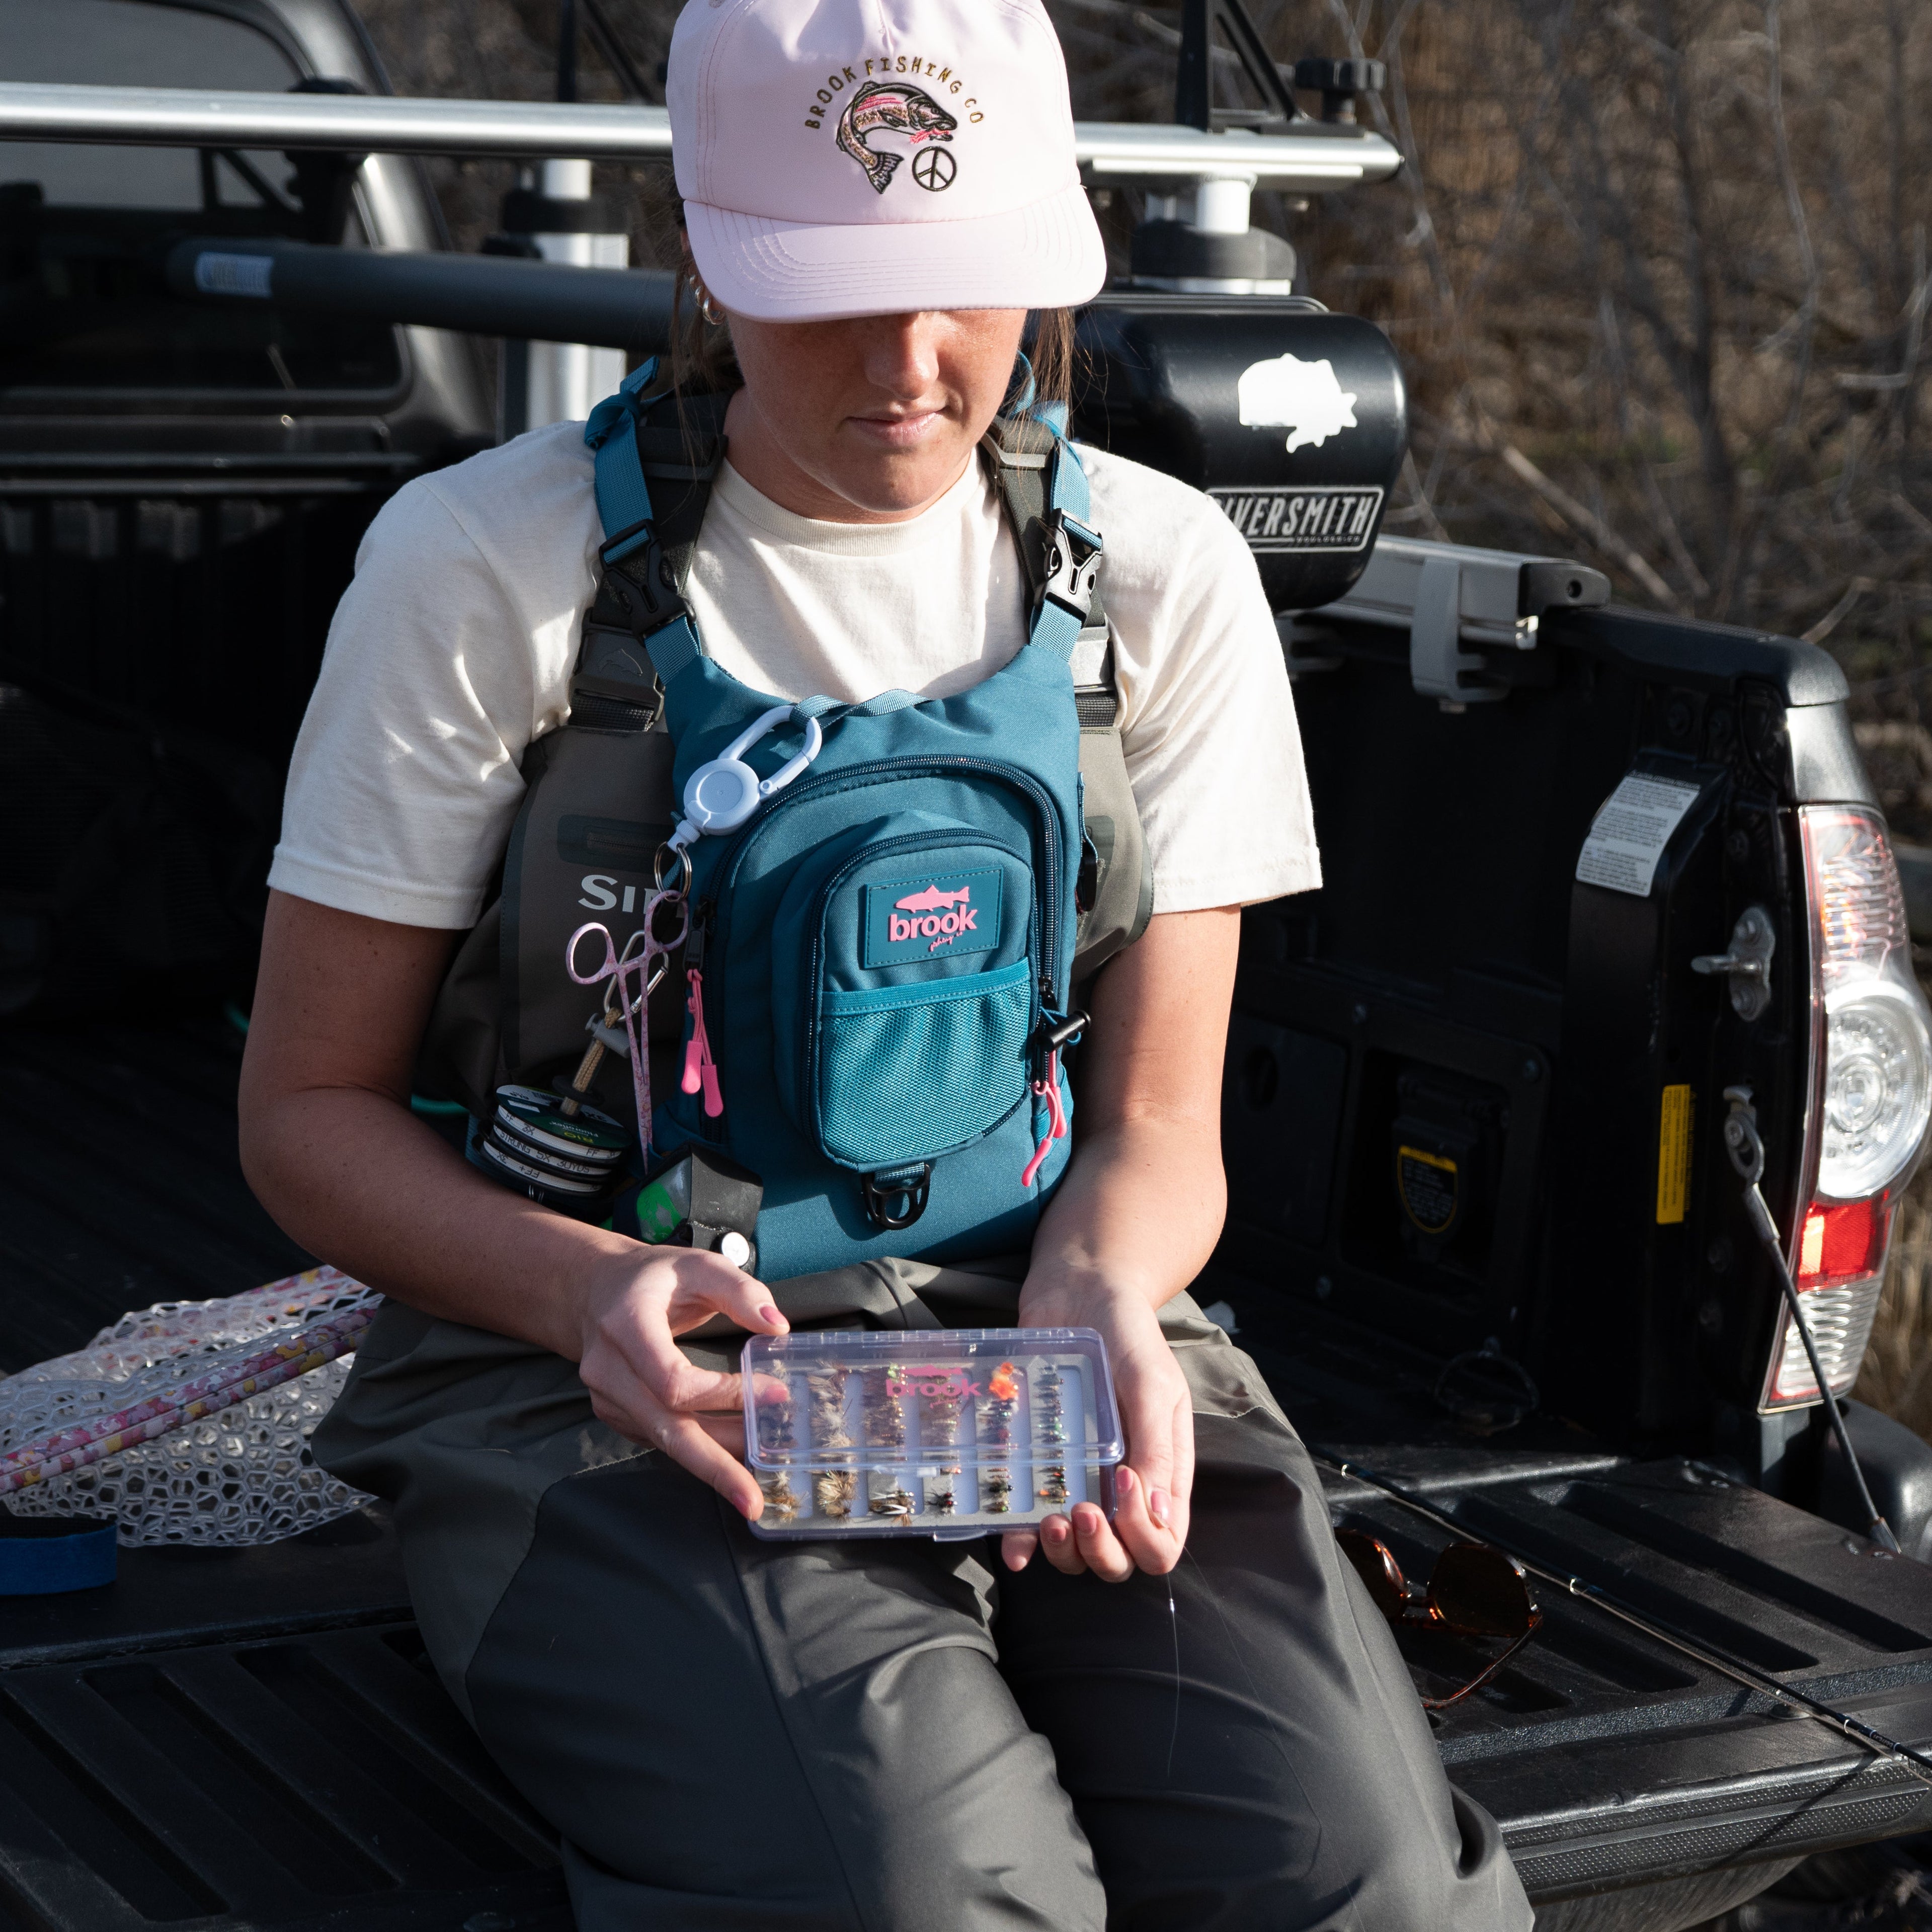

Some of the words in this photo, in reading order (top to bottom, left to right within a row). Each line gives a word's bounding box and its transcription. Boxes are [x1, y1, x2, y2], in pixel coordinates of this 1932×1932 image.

[805, 66, 857, 129] BROOK
[865, 56, 962, 94] FISHING
[964, 98, 984, 123] CO
[1214, 496, 1375, 536] VERSMITH
[890, 904, 978, 941] brook
[564, 1132, 594, 1143] RIO
[536, 1150, 551, 1163] 5X
[586, 1148, 600, 1157] FF
[886, 1378, 982, 1397] brook
